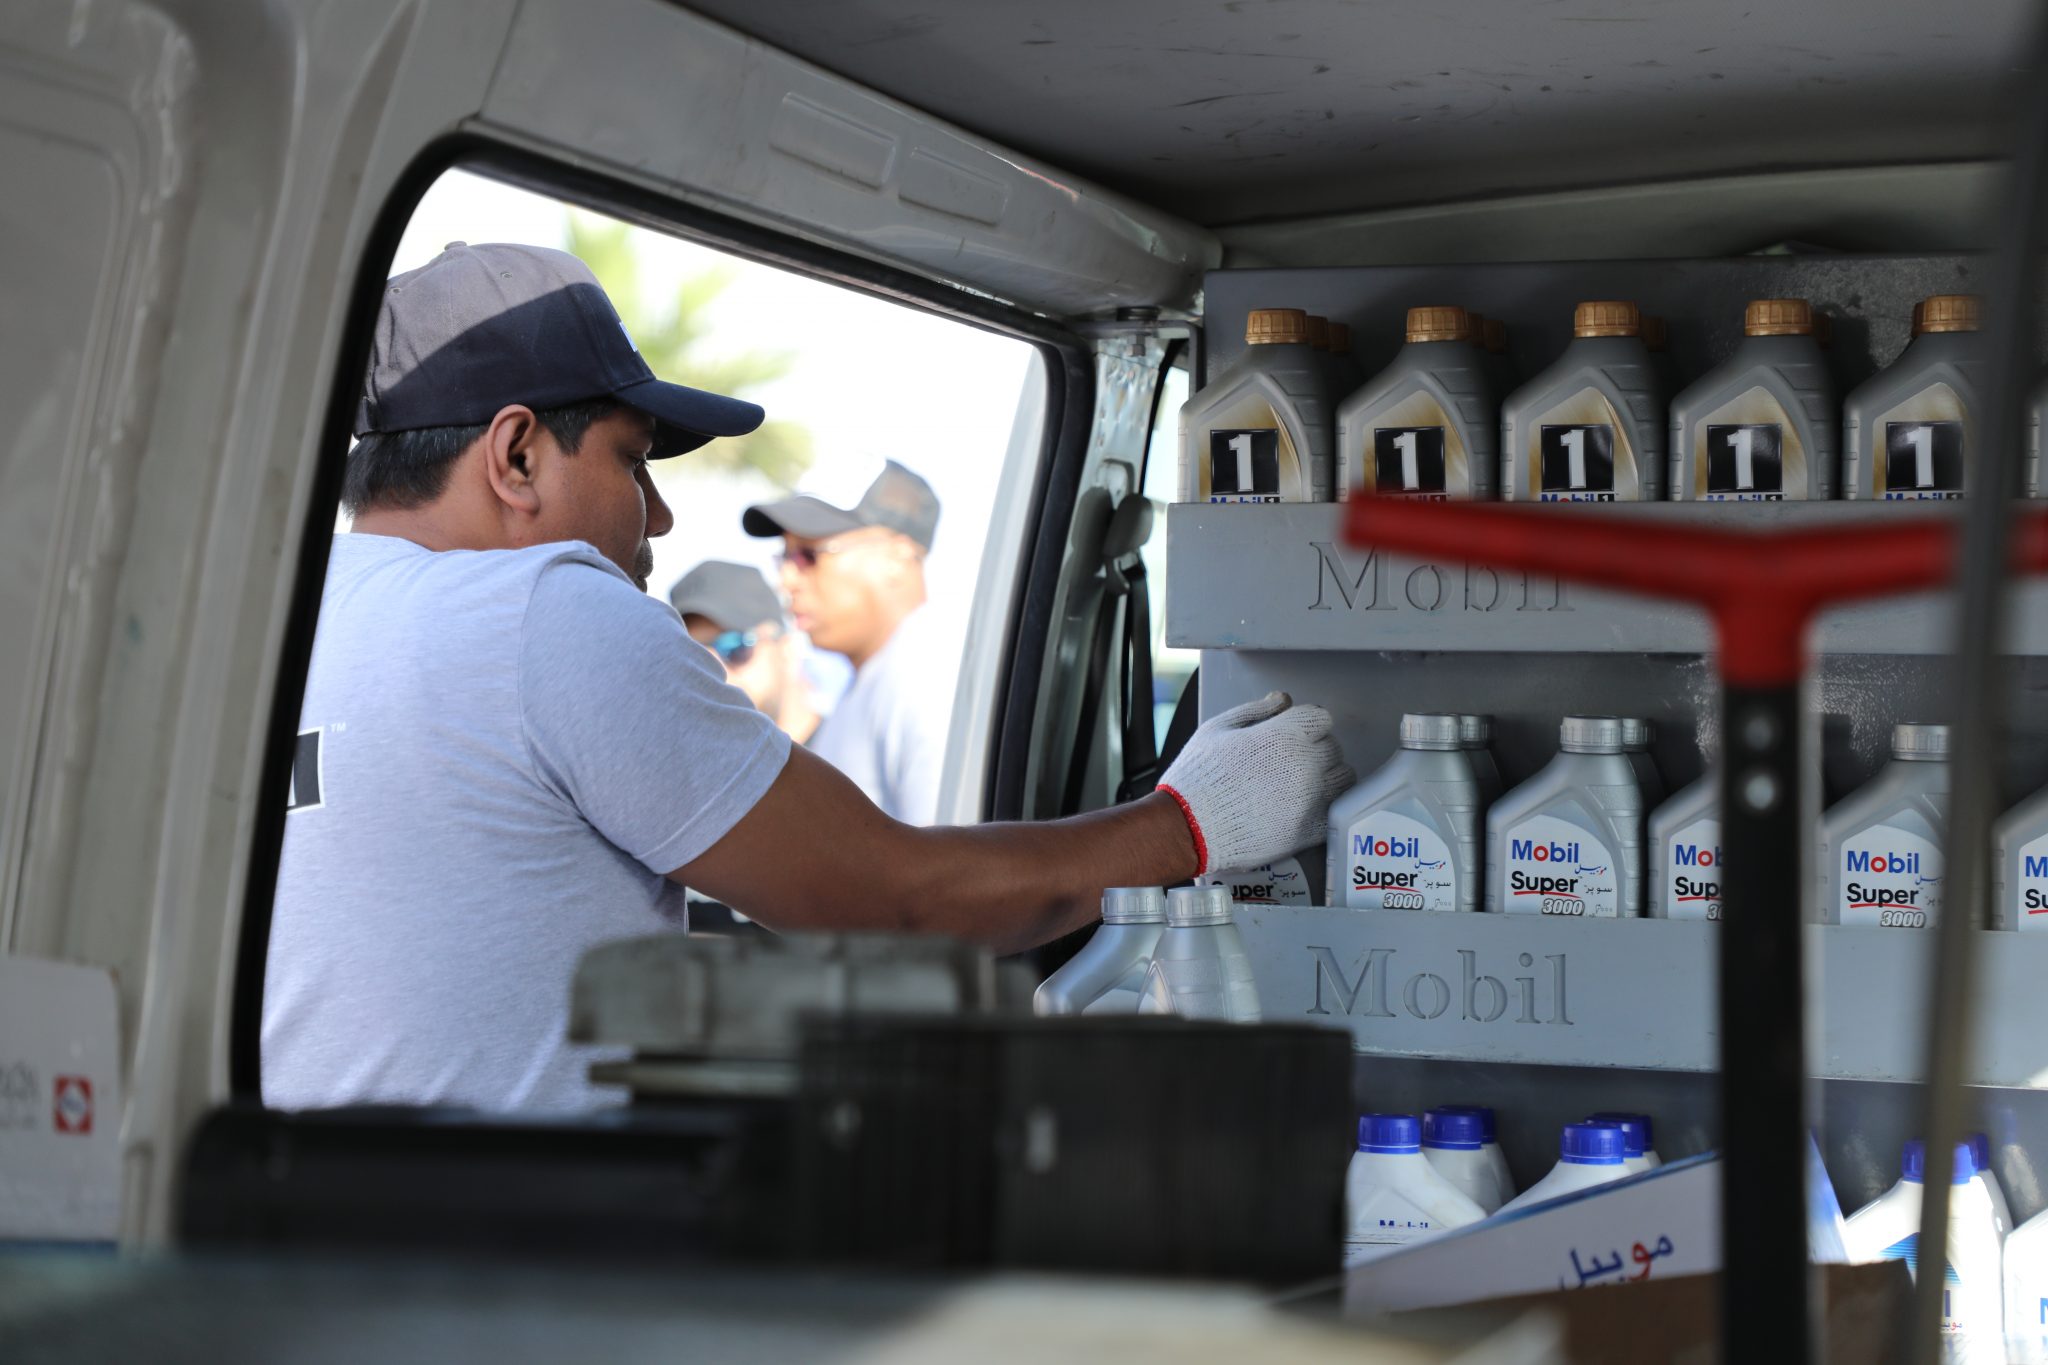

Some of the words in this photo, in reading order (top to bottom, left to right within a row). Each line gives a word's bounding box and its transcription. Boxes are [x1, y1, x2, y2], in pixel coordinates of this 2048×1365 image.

[1229, 434, 1253, 492] 1
[1393, 432, 1419, 490] 1
[1560, 429, 1586, 489] 1
[1727, 429, 1754, 490] 1
[1907, 426, 1935, 488] 1
[1353, 834, 1419, 858] Mobil
[1511, 839, 1579, 863] Mobil
[1847, 850, 1919, 874] Mobil
[1353, 865, 1419, 890] Super
[1511, 870, 1579, 895] Super
[1675, 876, 1722, 901] Sup
[1384, 893, 1424, 909] 3000
[1542, 898, 1584, 915] 3000
[1847, 882, 1919, 908] Super
[1881, 911, 1926, 928] 3000
[1306, 945, 1574, 1025] Mobil
